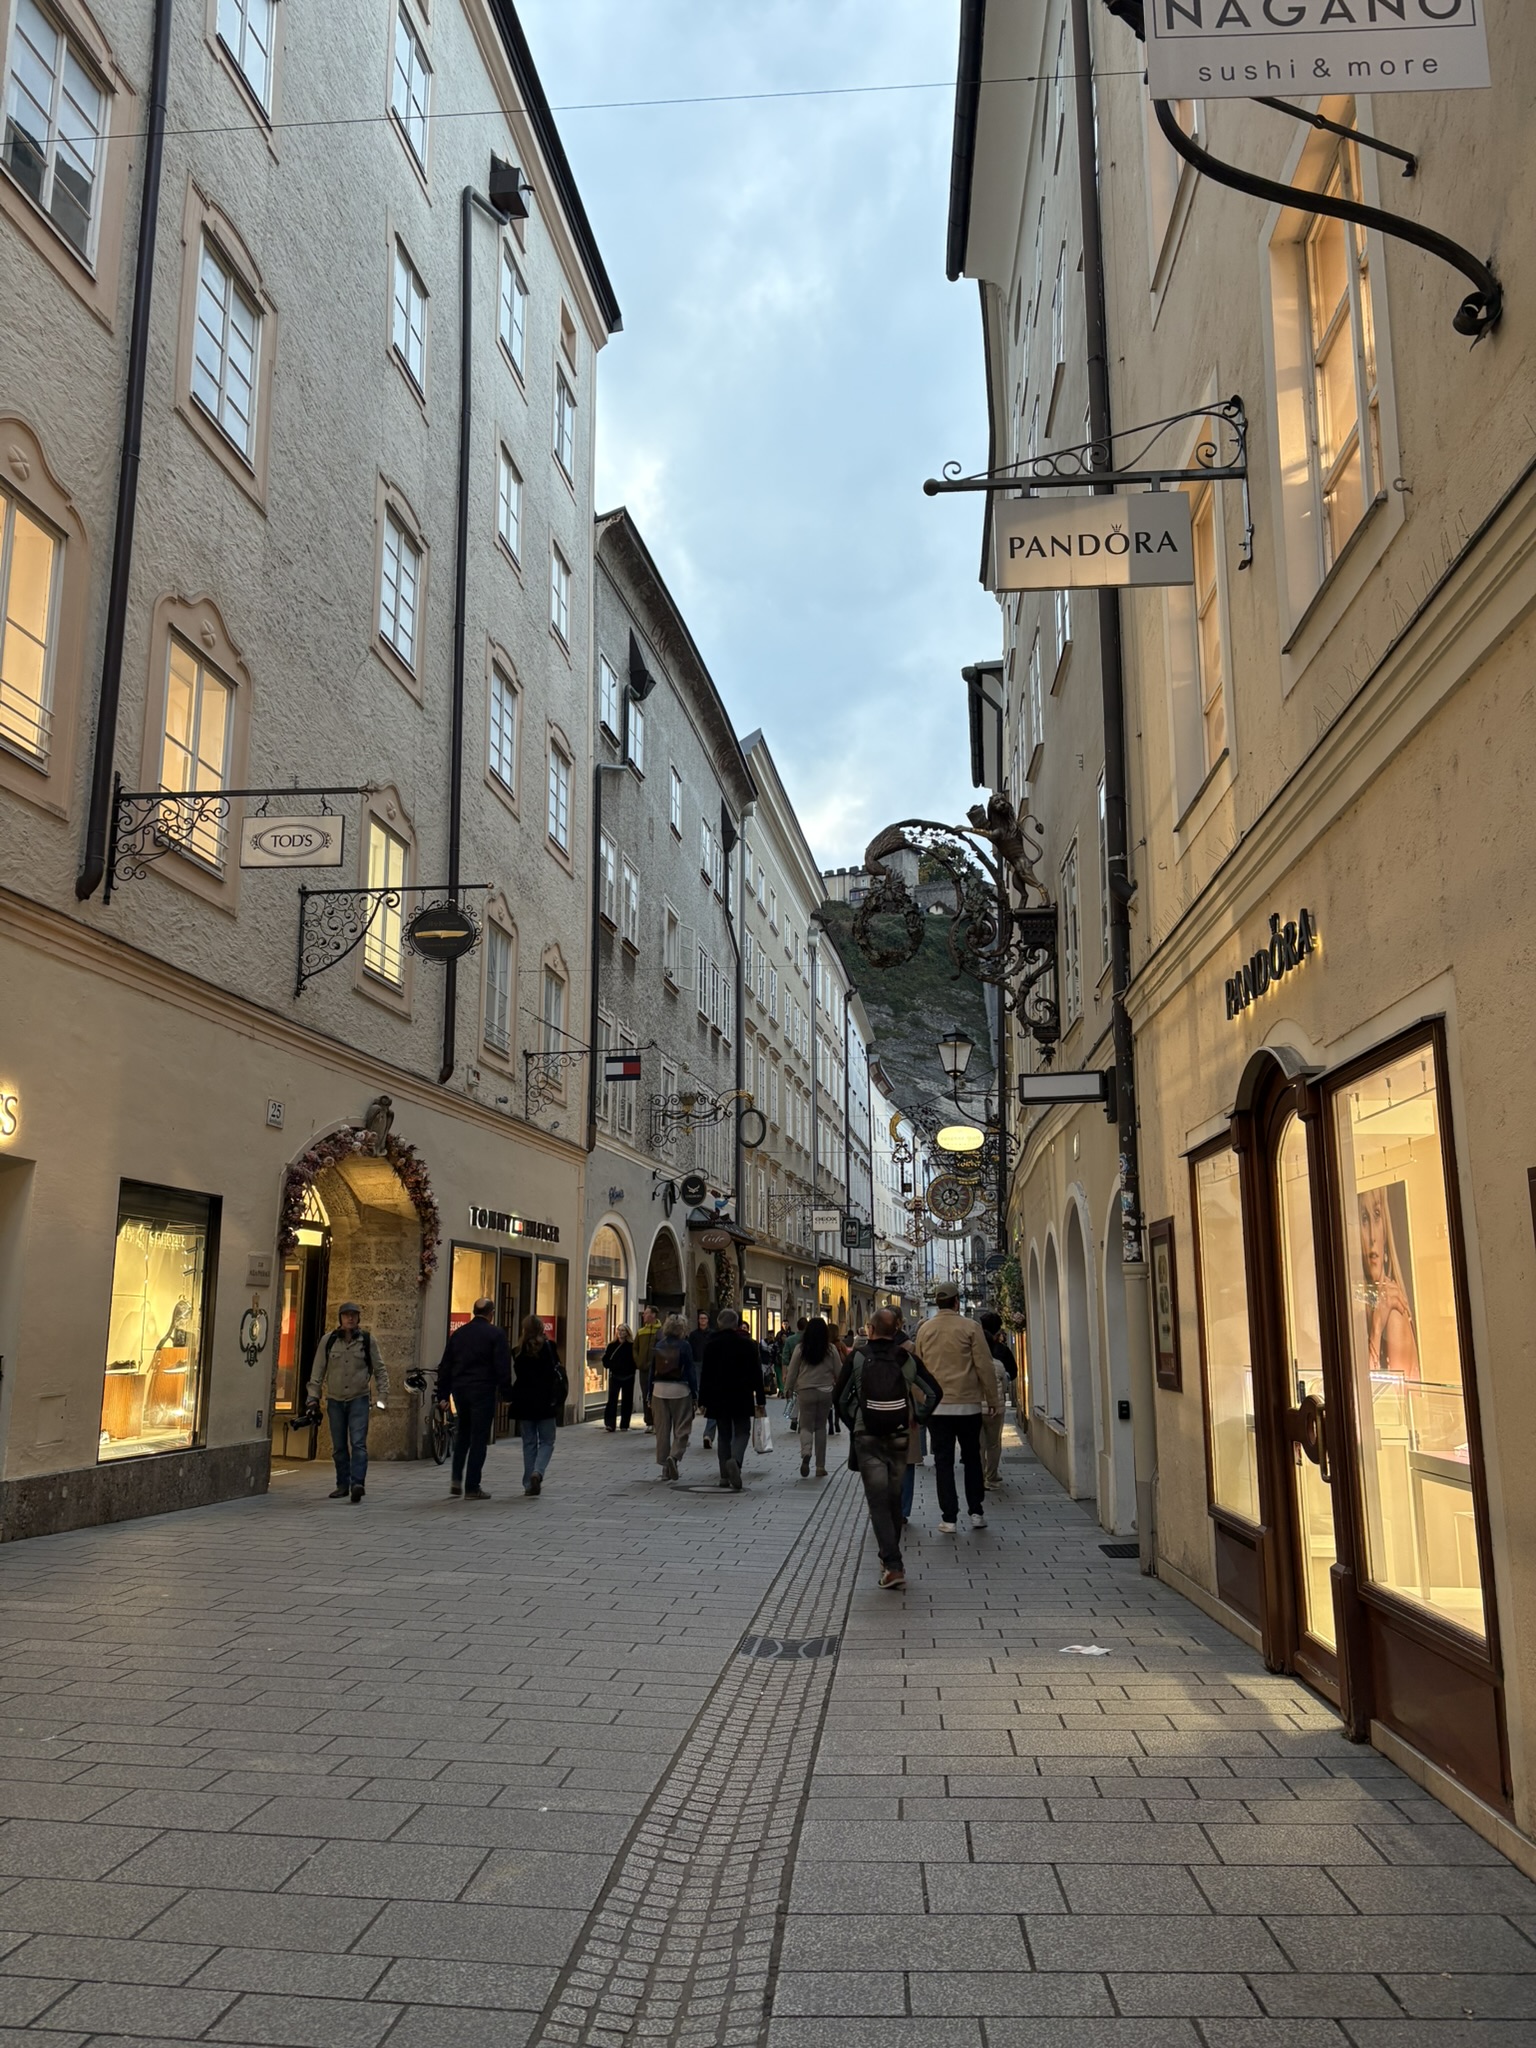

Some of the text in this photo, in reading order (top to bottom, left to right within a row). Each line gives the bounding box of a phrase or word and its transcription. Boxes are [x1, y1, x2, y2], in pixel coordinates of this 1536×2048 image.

[1165, 0, 1463, 30] NAGANO
[1199, 57, 1440, 82] sushi & more
[1008, 528, 1179, 560] PANDORA
[271, 833, 313, 848] TOD'S
[1225, 908, 1315, 1021] PANDORA
[271, 1102, 282, 1119] 25
[469, 1206, 511, 1233] TOMMY
